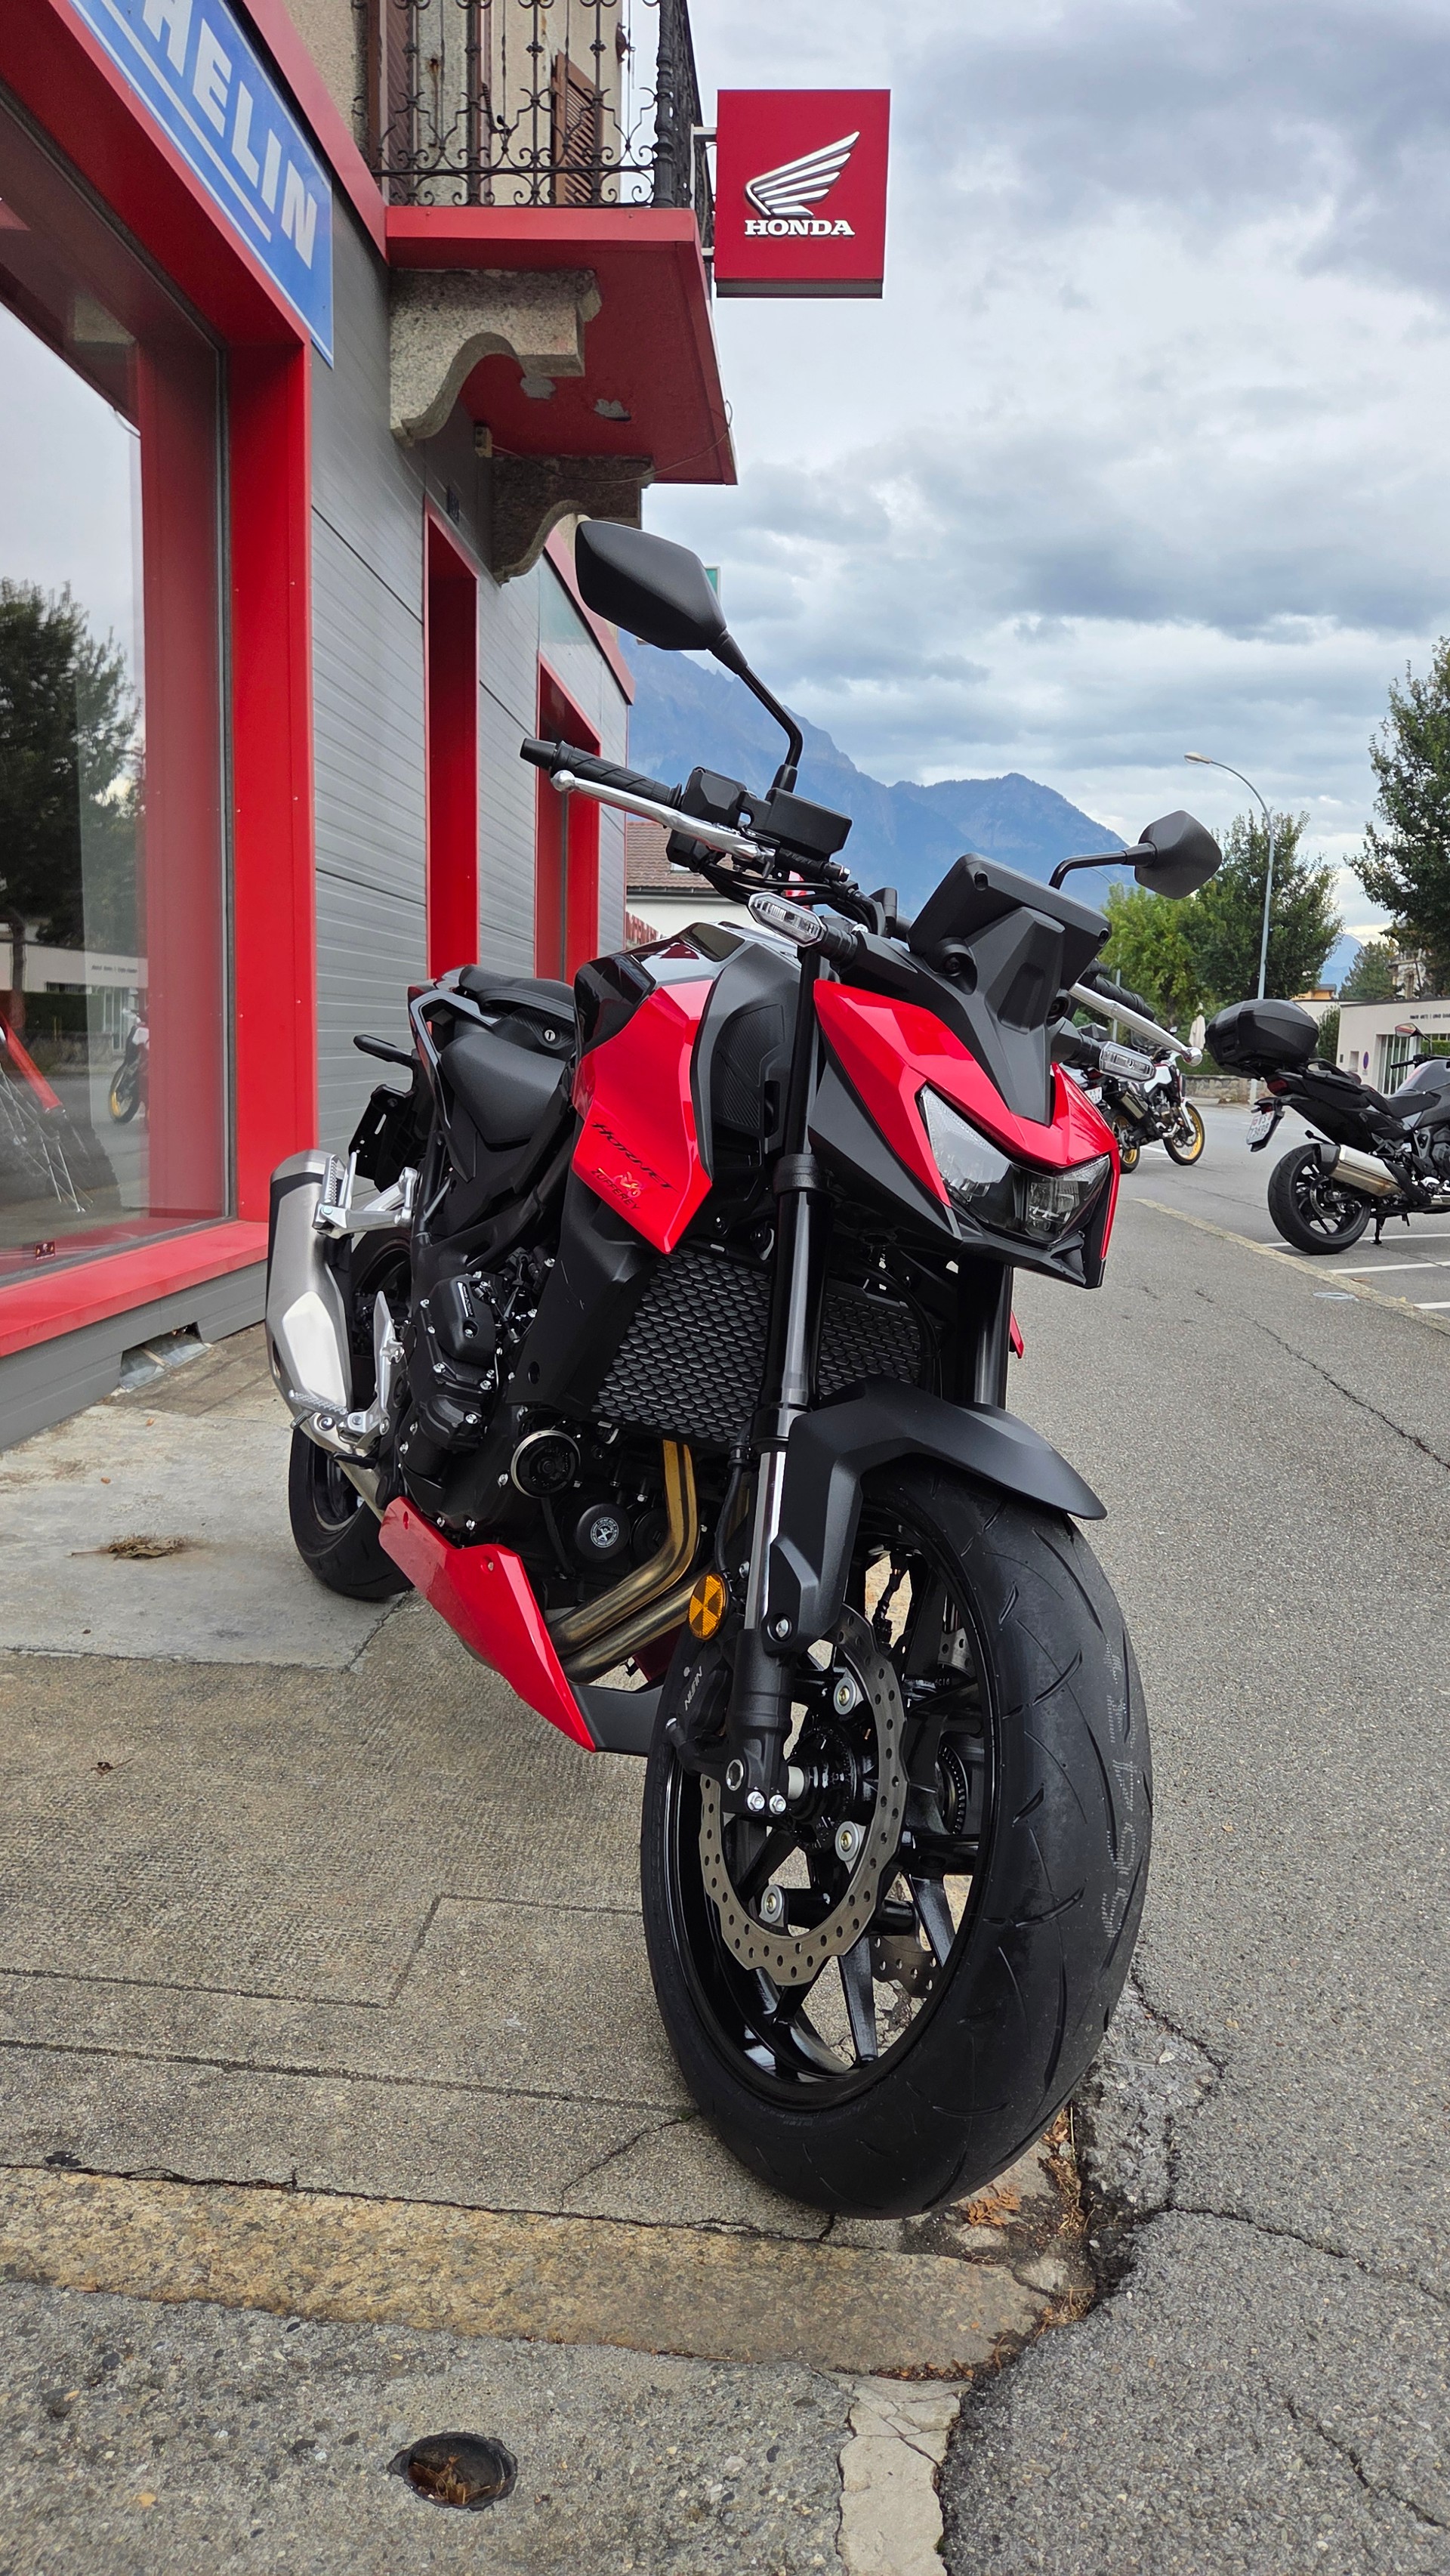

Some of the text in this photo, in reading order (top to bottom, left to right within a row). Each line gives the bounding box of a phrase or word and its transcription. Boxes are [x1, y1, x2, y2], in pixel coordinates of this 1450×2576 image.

[744, 219, 856, 236] HONDA
[591, 1122, 679, 1193] HORNET
[591, 1169, 640, 1209] ZUFFEREY
